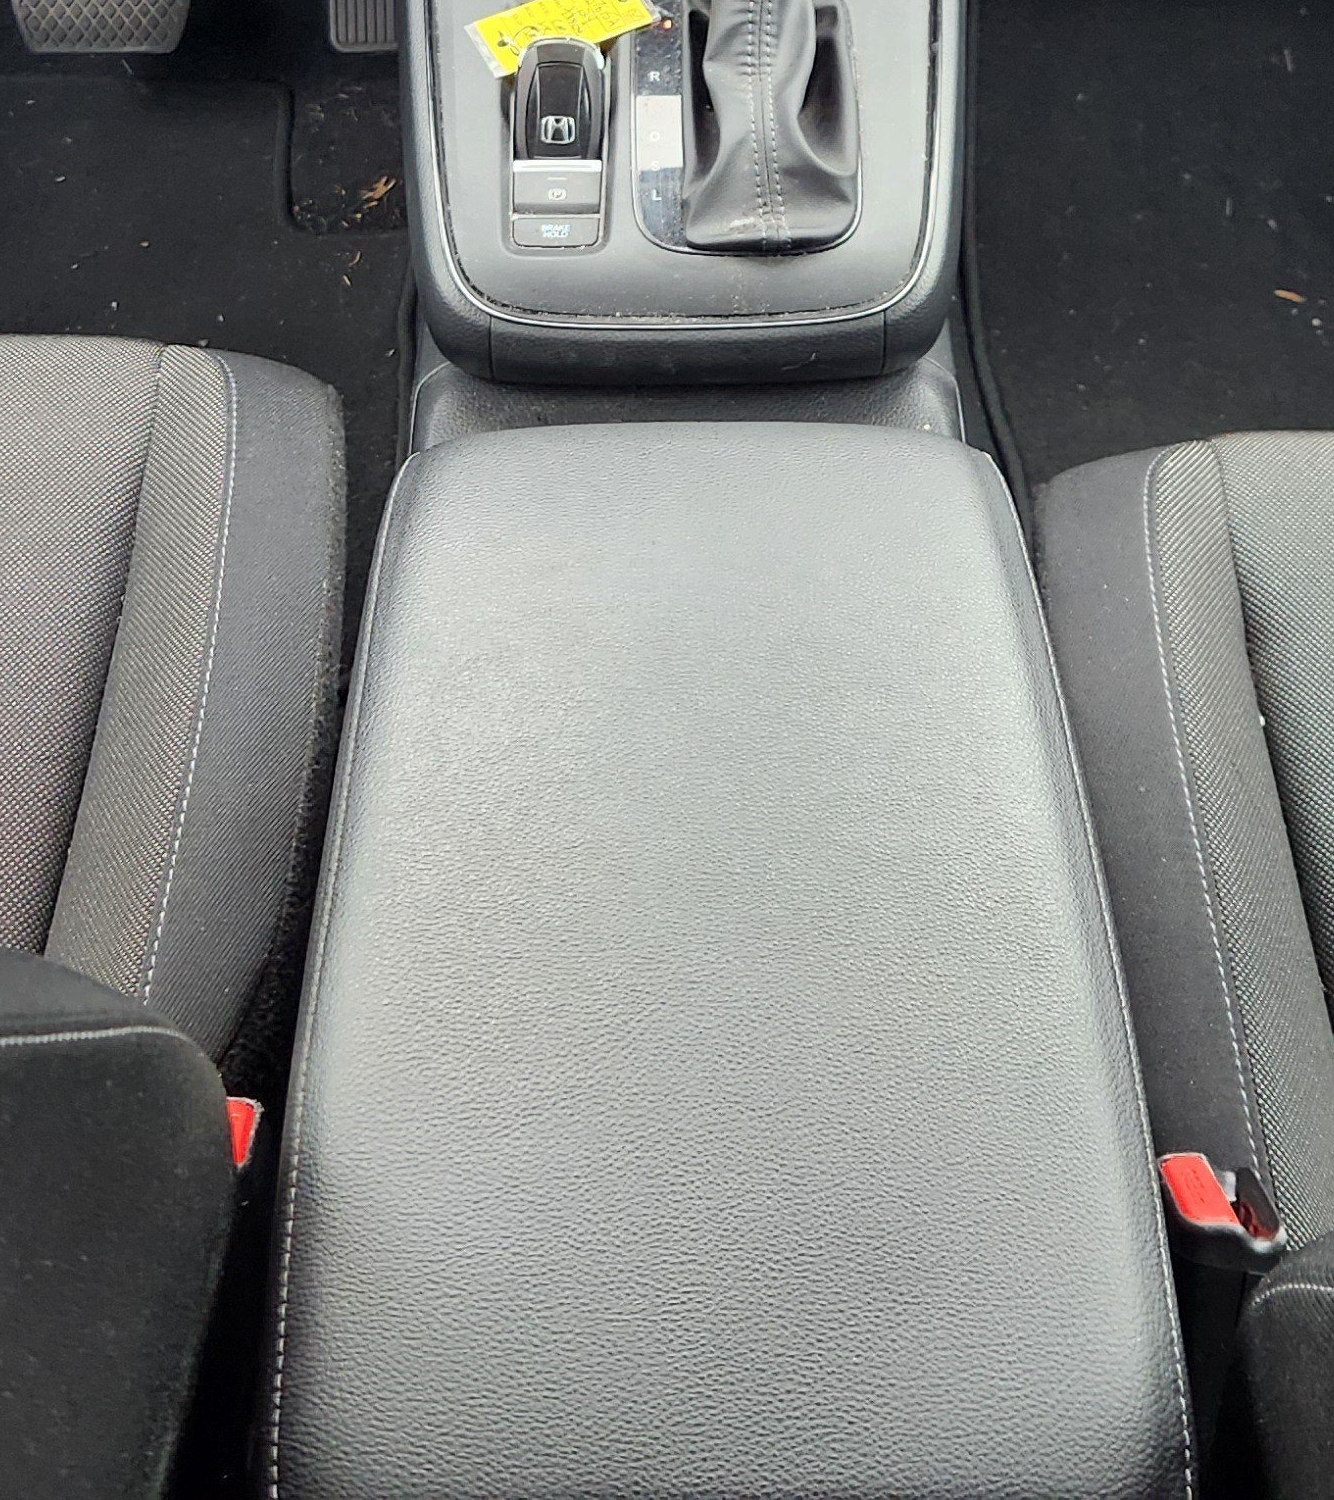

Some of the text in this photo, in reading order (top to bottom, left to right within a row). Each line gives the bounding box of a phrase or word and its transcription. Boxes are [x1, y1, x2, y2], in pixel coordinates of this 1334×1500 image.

[649, 71, 661, 82] R
[649, 131, 660, 142] D
[652, 189, 662, 201] L
[541, 223, 571, 233] BRAKE
[542, 230, 569, 239] HOLD
